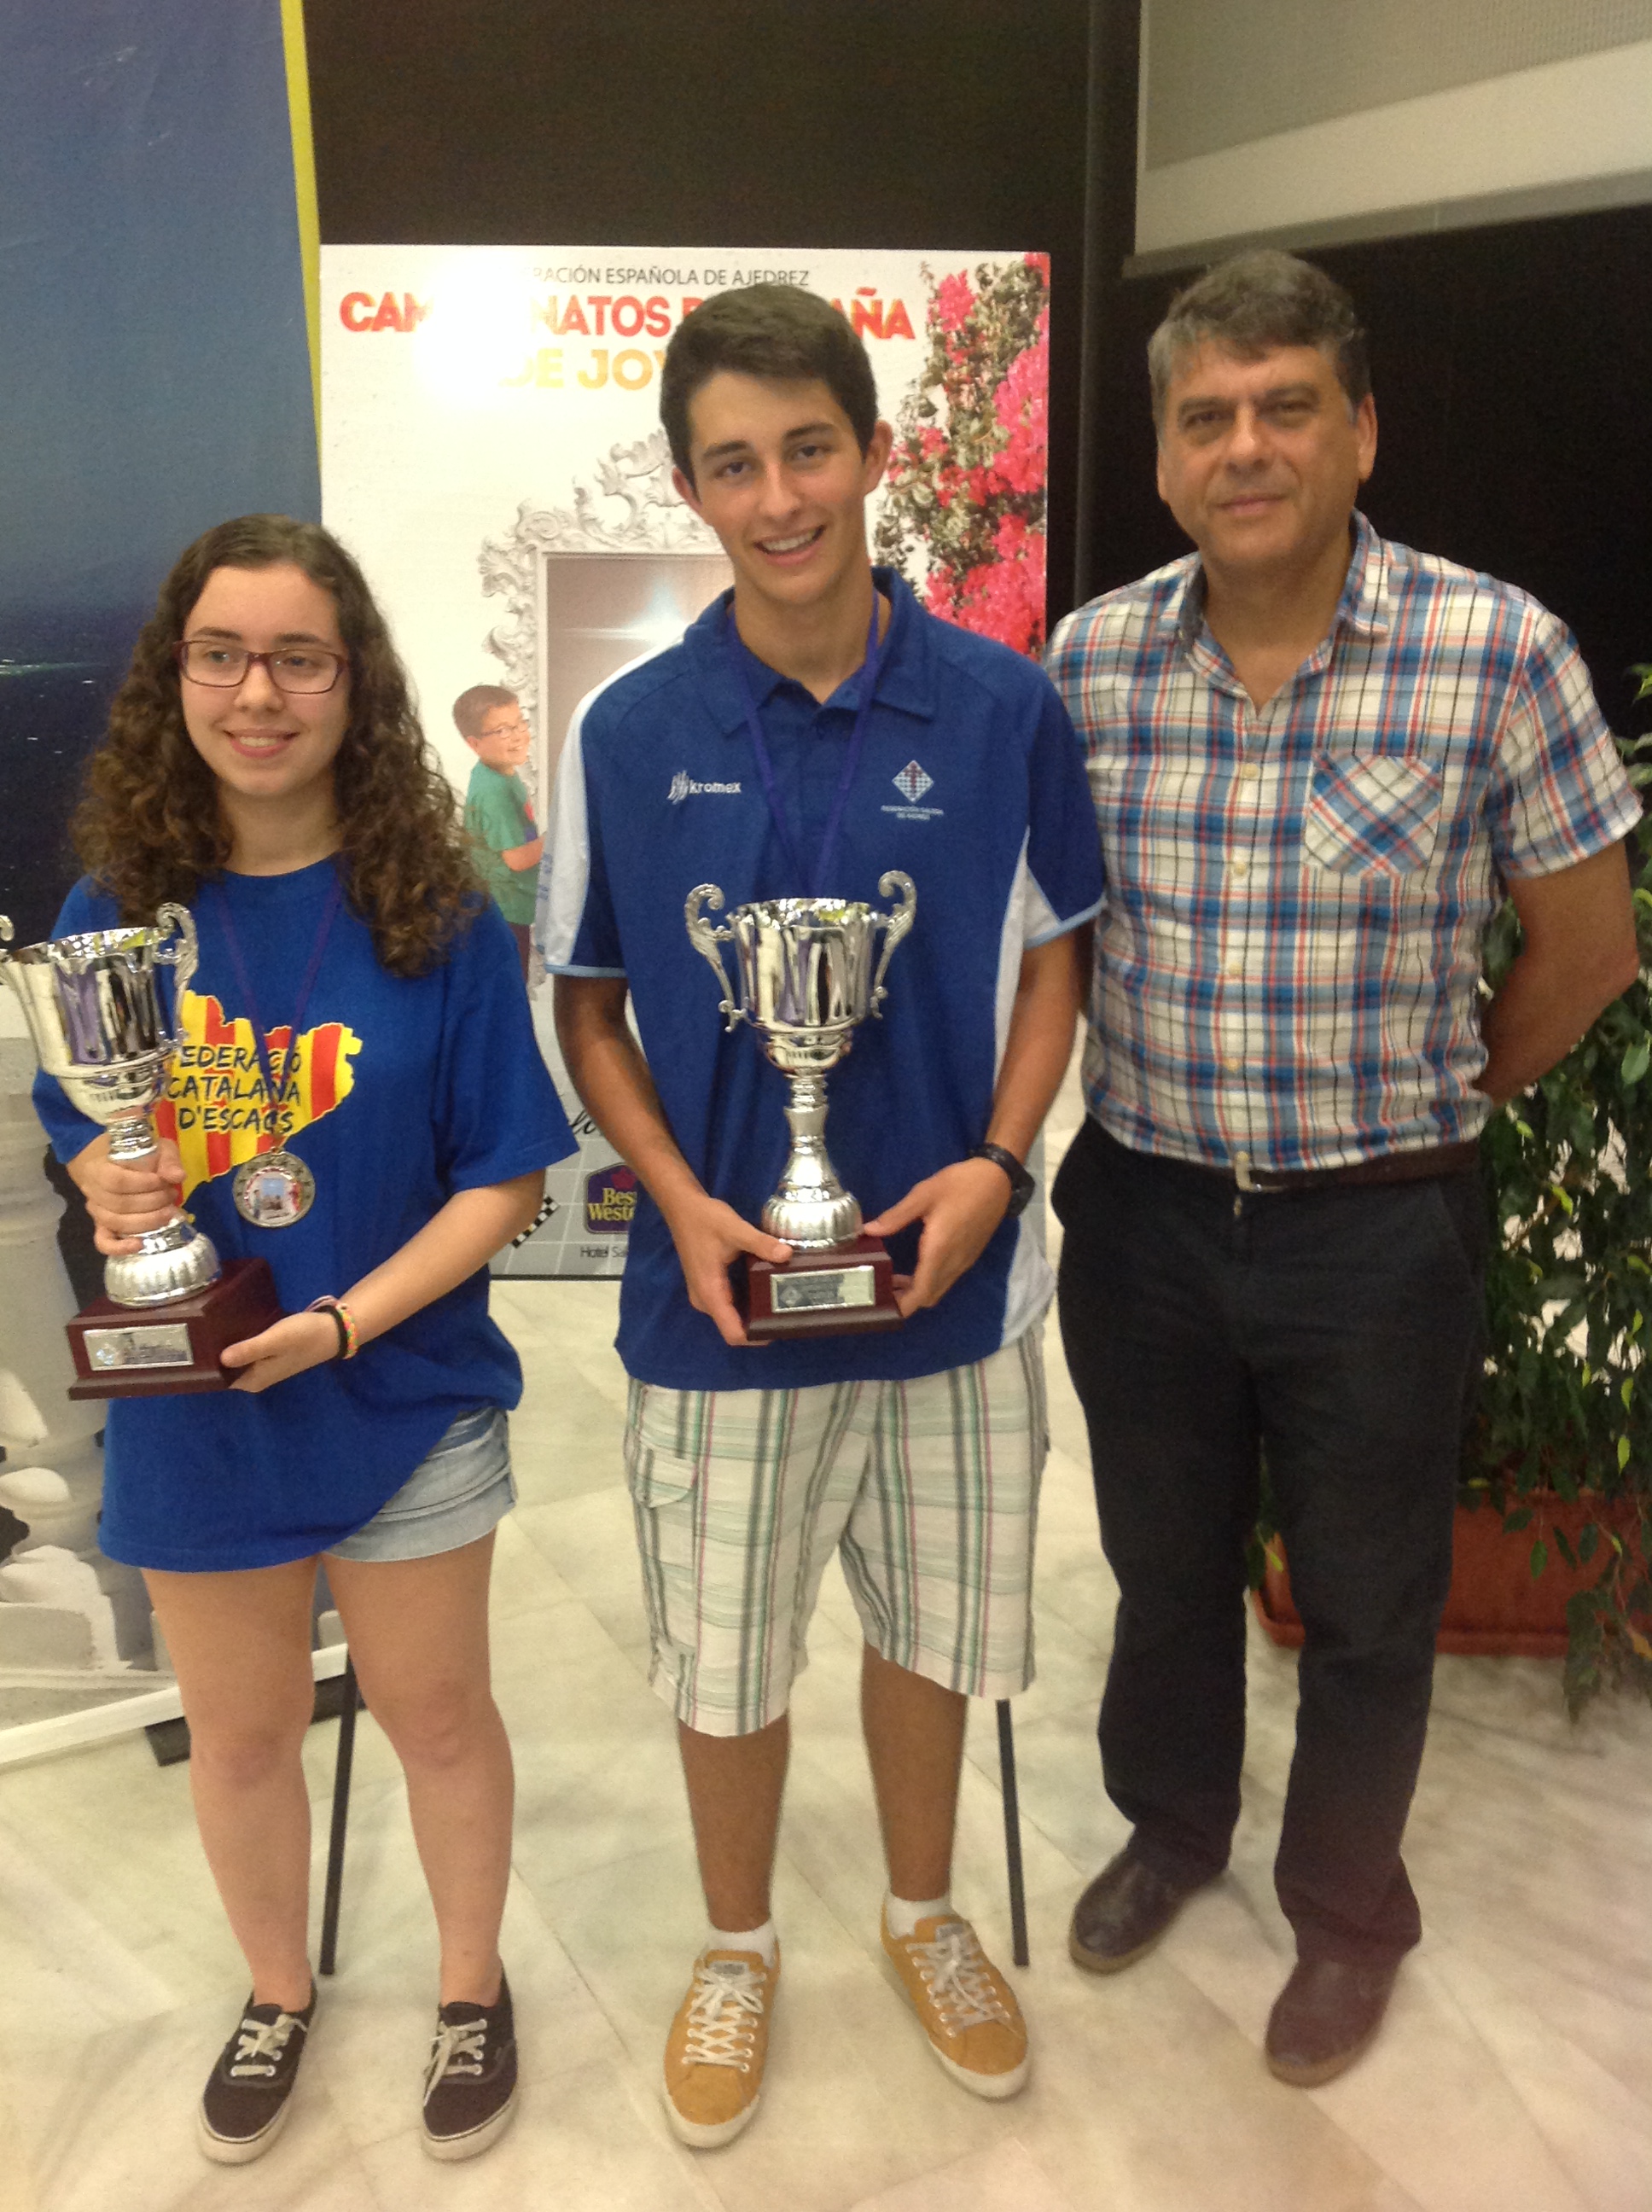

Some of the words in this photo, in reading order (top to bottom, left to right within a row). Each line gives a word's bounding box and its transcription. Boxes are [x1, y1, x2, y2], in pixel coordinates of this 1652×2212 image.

[606, 265, 699, 285] ESPAÑOLA
[704, 270, 726, 285] DE
[731, 270, 809, 287] AJEDREZ
[602, 1187, 637, 1206] Bes
[580, 1245, 609, 1259] Hotel
